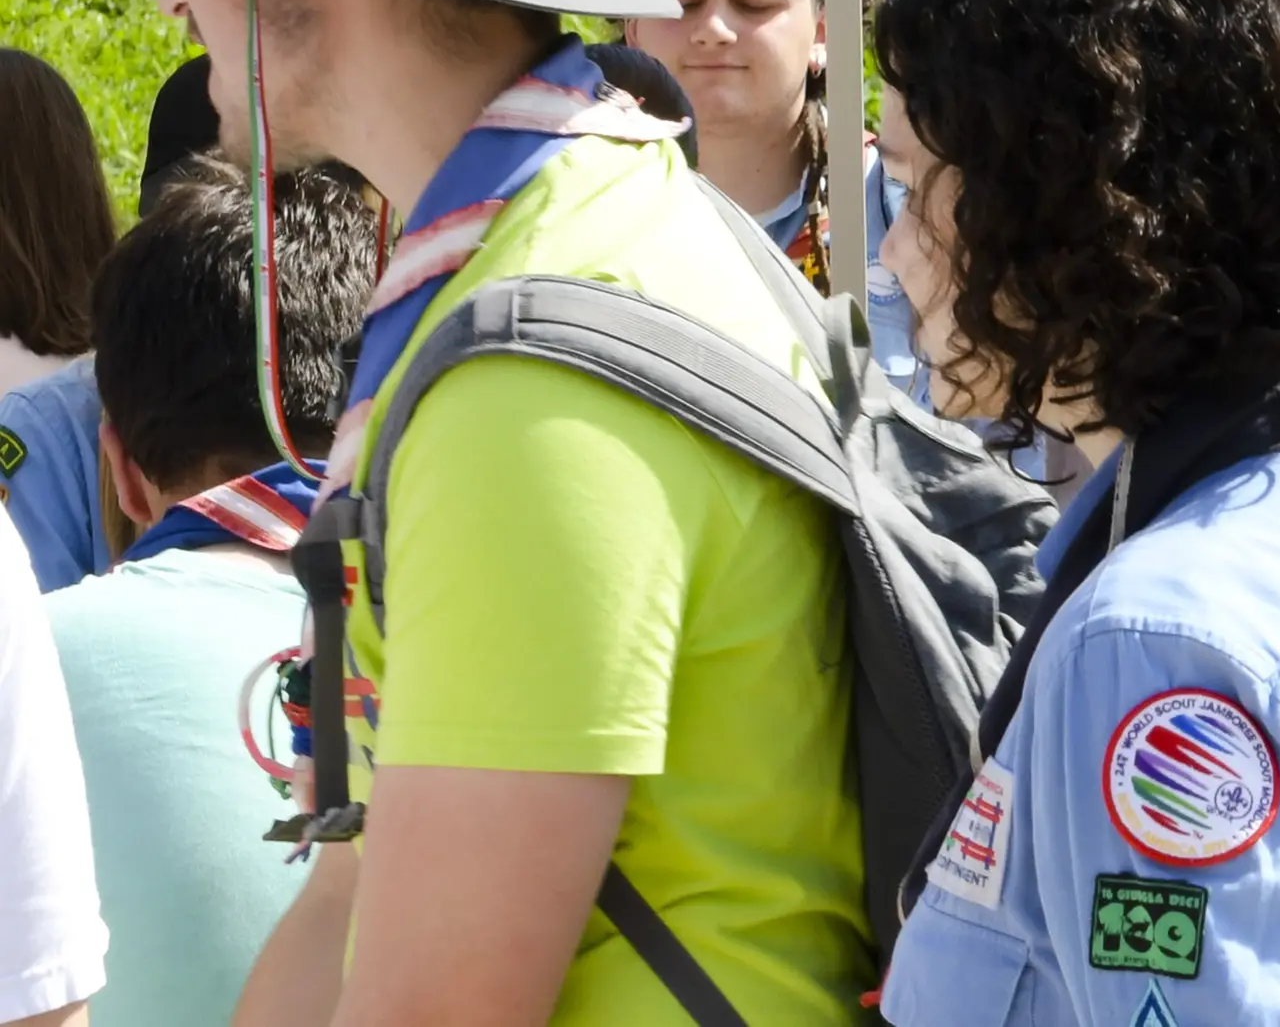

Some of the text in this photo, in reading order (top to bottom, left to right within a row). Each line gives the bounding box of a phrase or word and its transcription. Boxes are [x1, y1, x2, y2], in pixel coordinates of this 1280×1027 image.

[1154, 698, 1198, 718] SCOUT
[1199, 699, 1258, 743] JAMBOREE
[1121, 712, 1155, 749] WORLD
[1252, 743, 1274, 784] SCOUT
[1239, 784, 1274, 837] MONDIAL
